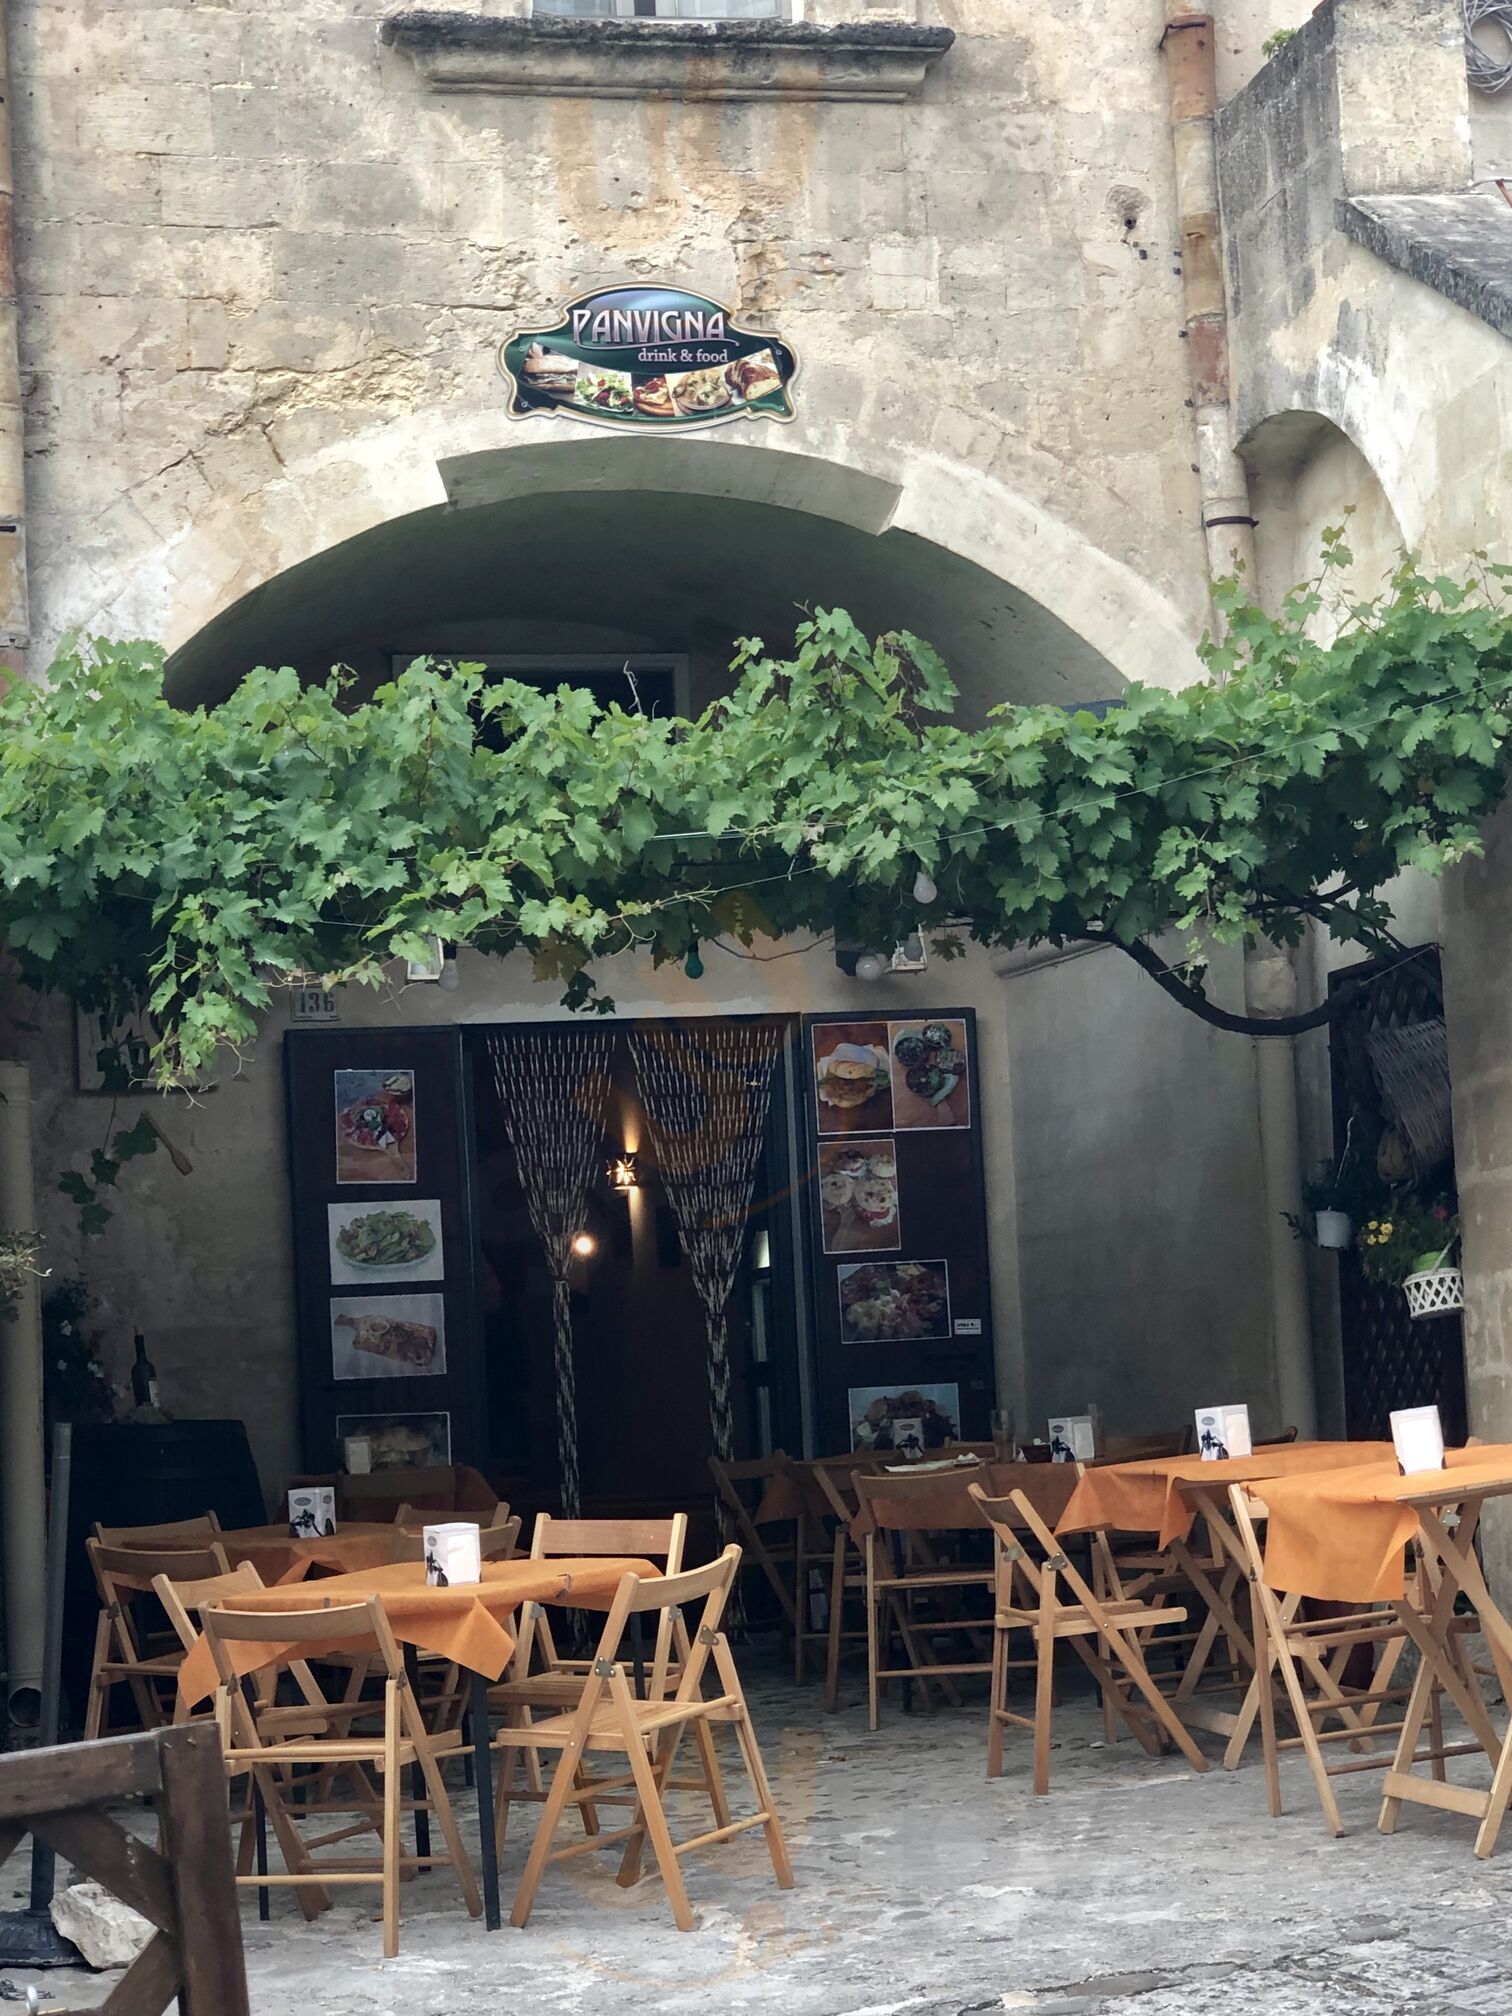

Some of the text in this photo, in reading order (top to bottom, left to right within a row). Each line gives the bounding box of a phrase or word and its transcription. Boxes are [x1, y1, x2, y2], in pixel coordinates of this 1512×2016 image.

[572, 309, 733, 347] PANVIGNA
[638, 349, 729, 363] drink & food
[301, 991, 335, 1013] 136
